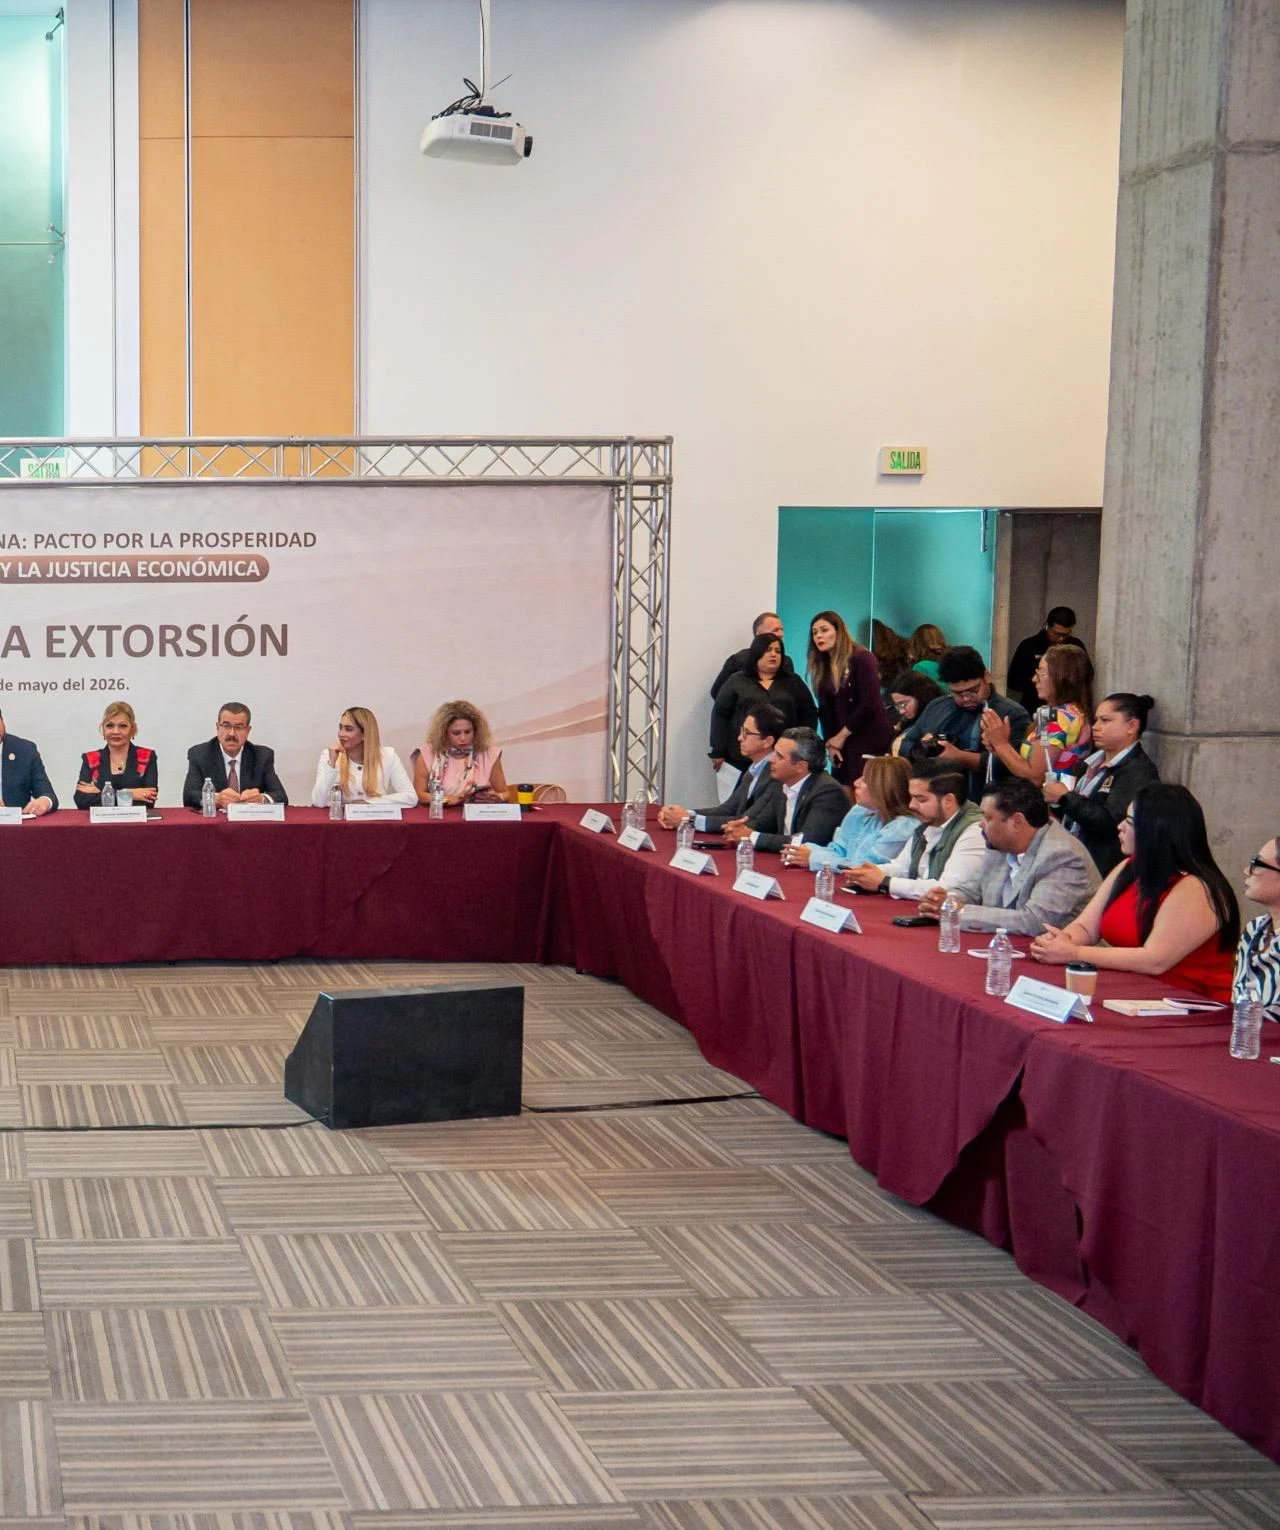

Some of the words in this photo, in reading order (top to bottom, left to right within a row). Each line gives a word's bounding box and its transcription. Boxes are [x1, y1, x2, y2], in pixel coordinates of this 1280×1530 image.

[890, 451, 921, 469] SALIDA
[34, 533, 97, 549] PACTO
[104, 533, 144, 548] POR
[150, 532, 174, 548] LA
[180, 531, 317, 548] PROSPERIDAD
[1, 563, 11, 578] Y
[18, 562, 42, 578] LA
[47, 561, 131, 578] JUSTICIA
[138, 556, 260, 577] ECONÓMICA
[46, 614, 289, 659] EXTORSIÓN
[18, 680, 58, 694] mayo
[63, 678, 85, 691] del
[90, 678, 130, 691] 2026.
